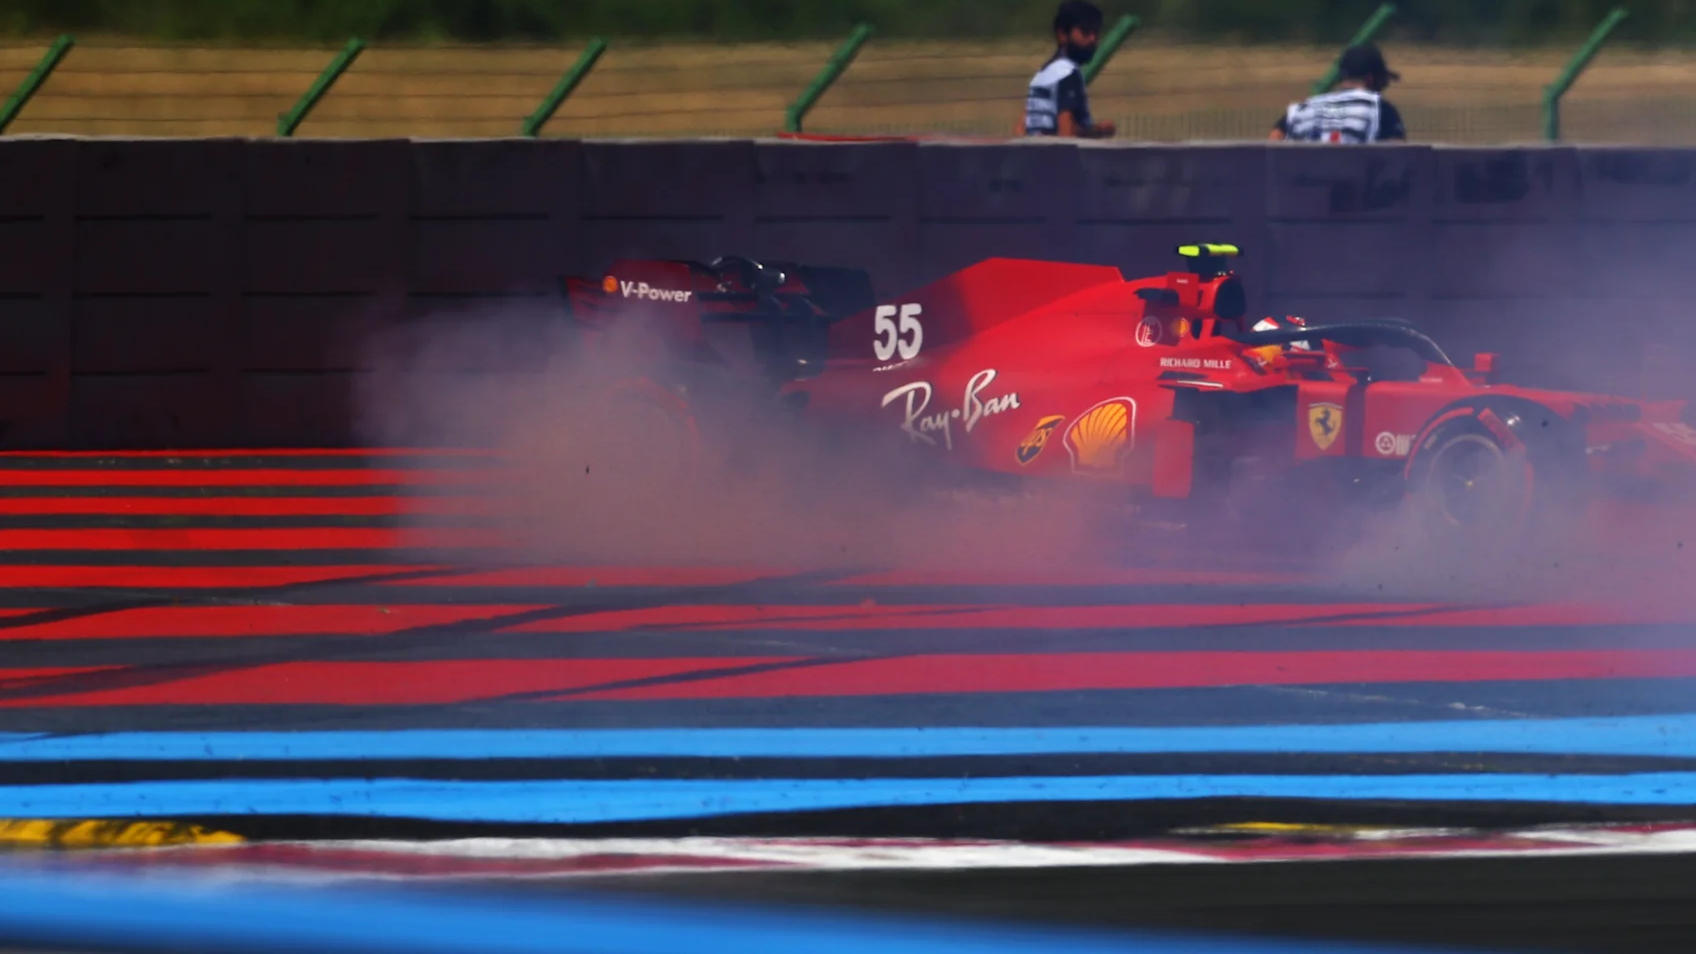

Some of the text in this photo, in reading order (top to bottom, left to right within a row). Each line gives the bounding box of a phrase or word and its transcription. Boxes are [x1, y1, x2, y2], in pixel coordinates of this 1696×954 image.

[620, 280, 692, 302] V-Power
[873, 303, 923, 361] 55
[1160, 357, 1232, 369] RICHARD MILLE
